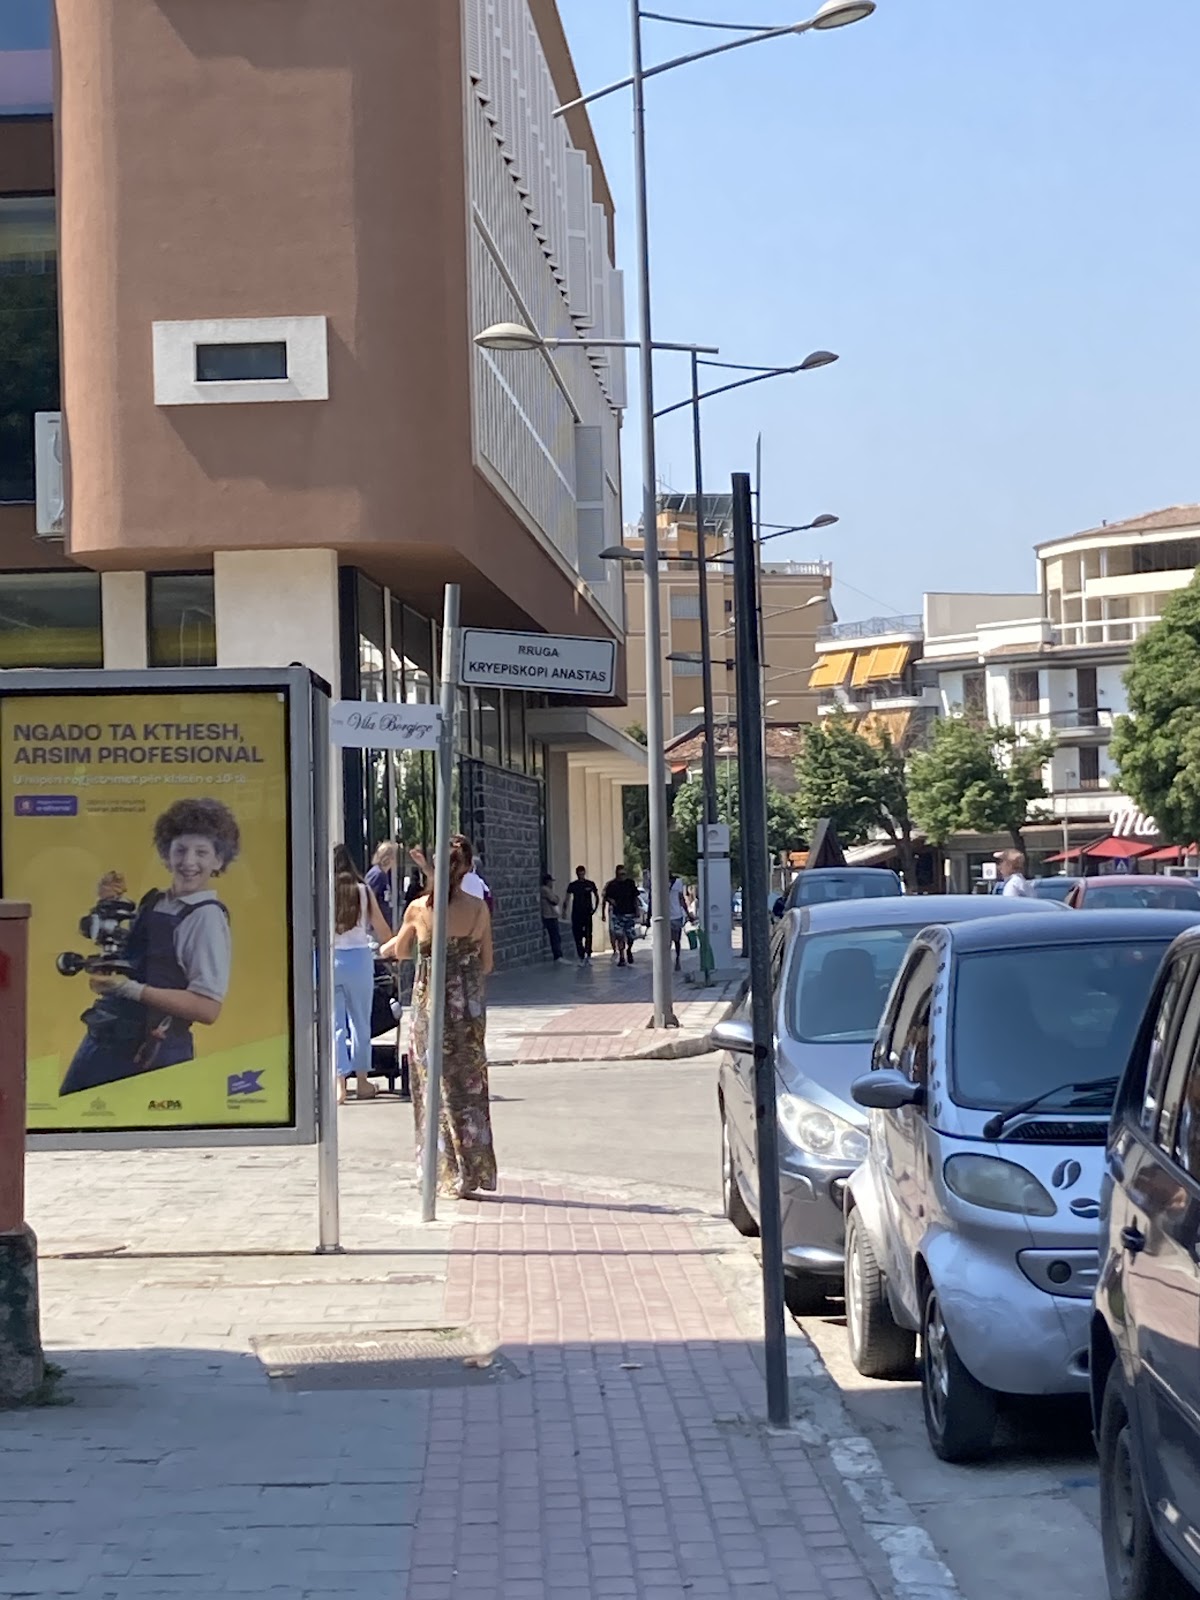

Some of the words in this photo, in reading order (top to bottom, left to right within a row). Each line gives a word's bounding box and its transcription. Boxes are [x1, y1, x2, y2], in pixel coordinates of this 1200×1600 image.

[518, 645, 559, 658] RRUGA
[469, 661, 548, 678] KRYEPISKOPI
[551, 668, 606, 682] ANASTAS
[347, 711, 379, 731] Vila
[13, 724, 102, 741] NGADO
[108, 723, 136, 740] TA
[143, 723, 244, 743] KTHESH,
[13, 747, 91, 764] ARSIM
[98, 746, 264, 763] PROFESIONAL
